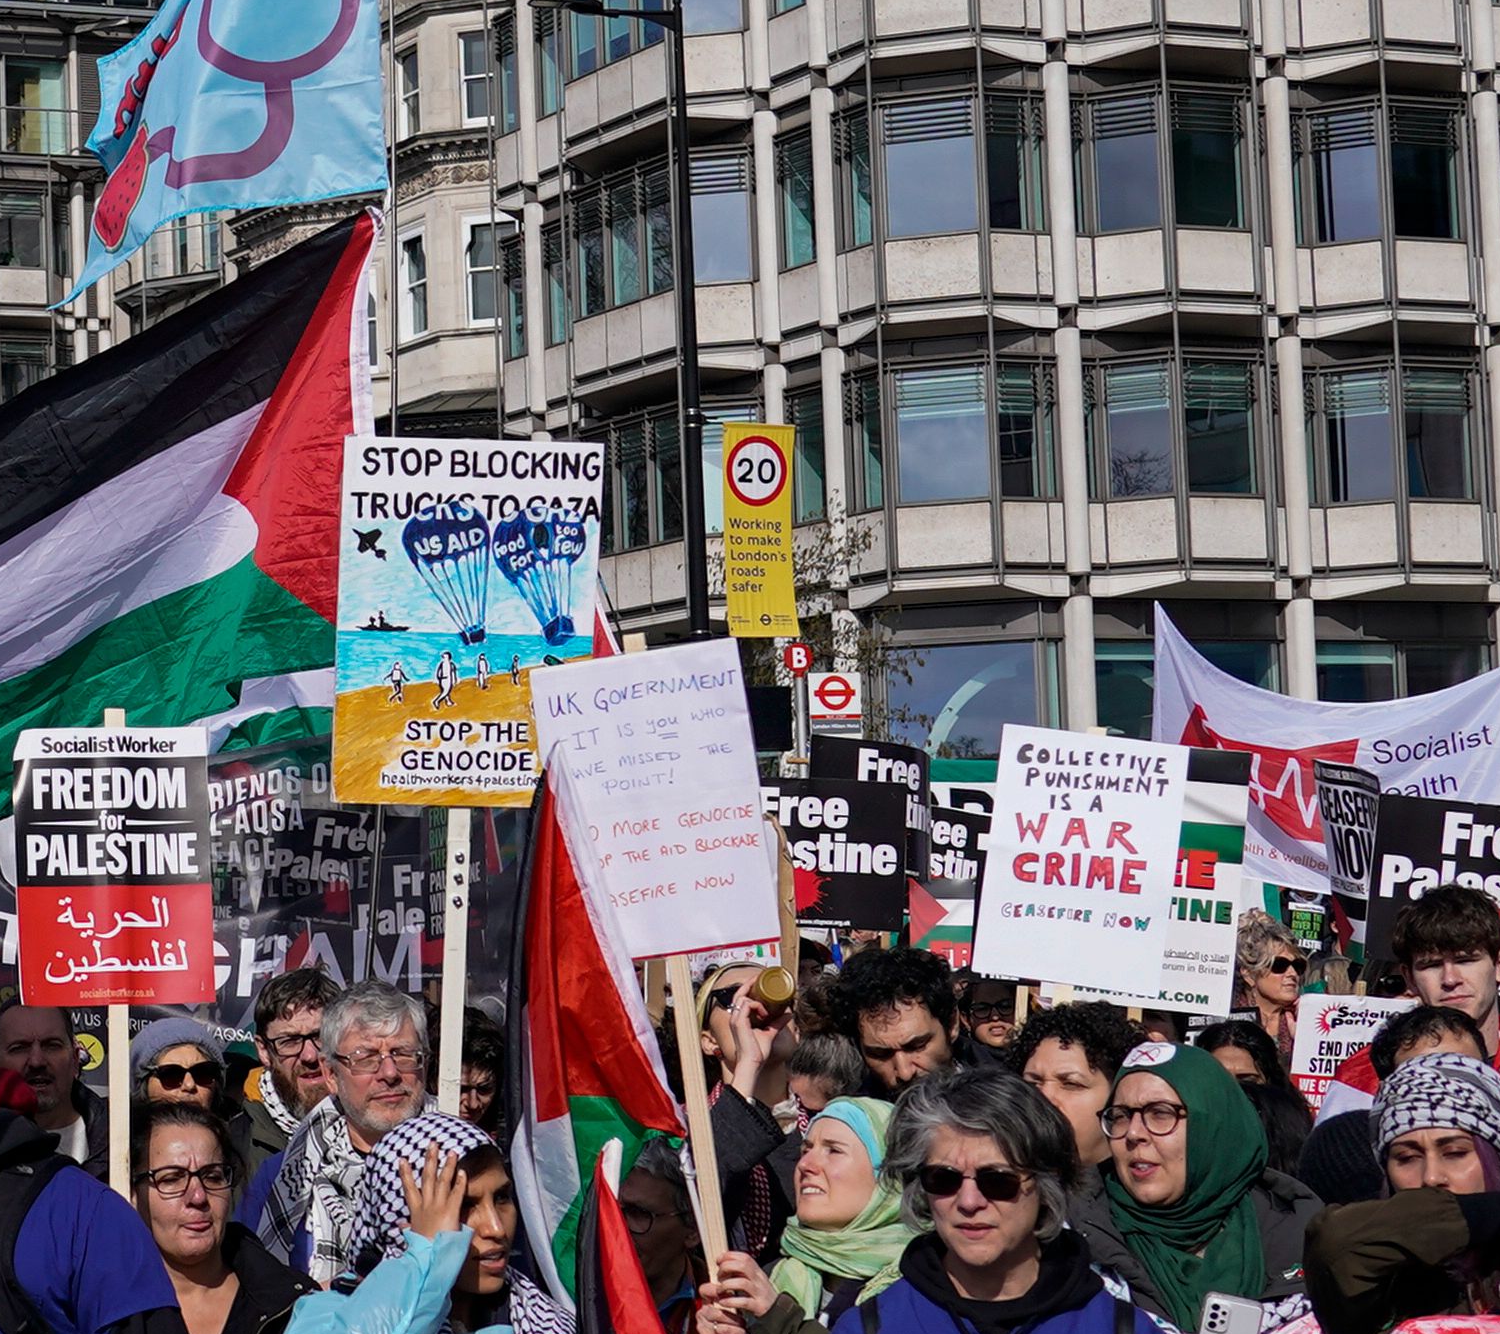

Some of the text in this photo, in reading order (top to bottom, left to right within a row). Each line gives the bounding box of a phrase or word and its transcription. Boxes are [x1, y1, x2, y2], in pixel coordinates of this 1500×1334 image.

[361, 446, 601, 482] STOP BLOCKING
[736, 457, 777, 485] 20
[351, 491, 601, 524] TRUCKS TO GAZA
[728, 517, 782, 534] Working
[729, 534, 782, 547] to make
[414, 527, 486, 556] US AID
[730, 549, 788, 563] London's
[731, 565, 766, 578] roads
[731, 580, 764, 593] safer
[791, 646, 808, 664] B
[548, 669, 738, 718] UK GOVERNMENT
[405, 720, 529, 743] STOP THE
[571, 707, 726, 751] IT IS WHO
[400, 749, 533, 772] GENOCIDE
[618, 742, 733, 768] MISSED THE
[1016, 743, 1168, 776] COLLECTIVE
[1372, 725, 1492, 765] Socialist
[857, 747, 921, 791] Free
[1025, 767, 1170, 798] PUNISHMENT
[31, 767, 187, 810] FREEDOM
[1050, 792, 1104, 813] IS A
[99, 810, 125, 831] for
[612, 803, 755, 839] MORE GENOCIDE
[759, 786, 849, 829] Free
[622, 832, 761, 865] THE AID BLOCKADE
[1015, 812, 1140, 855] WAR
[26, 833, 199, 877] PALESTINE
[694, 873, 735, 892] NOW
[1012, 851, 1148, 895] CRIME
[57, 896, 169, 938] الحرية
[1000, 901, 1151, 932] CEASEFIRE NOW
[45, 939, 189, 984] لفلسطين
[1318, 1040, 1342, 1057] END
